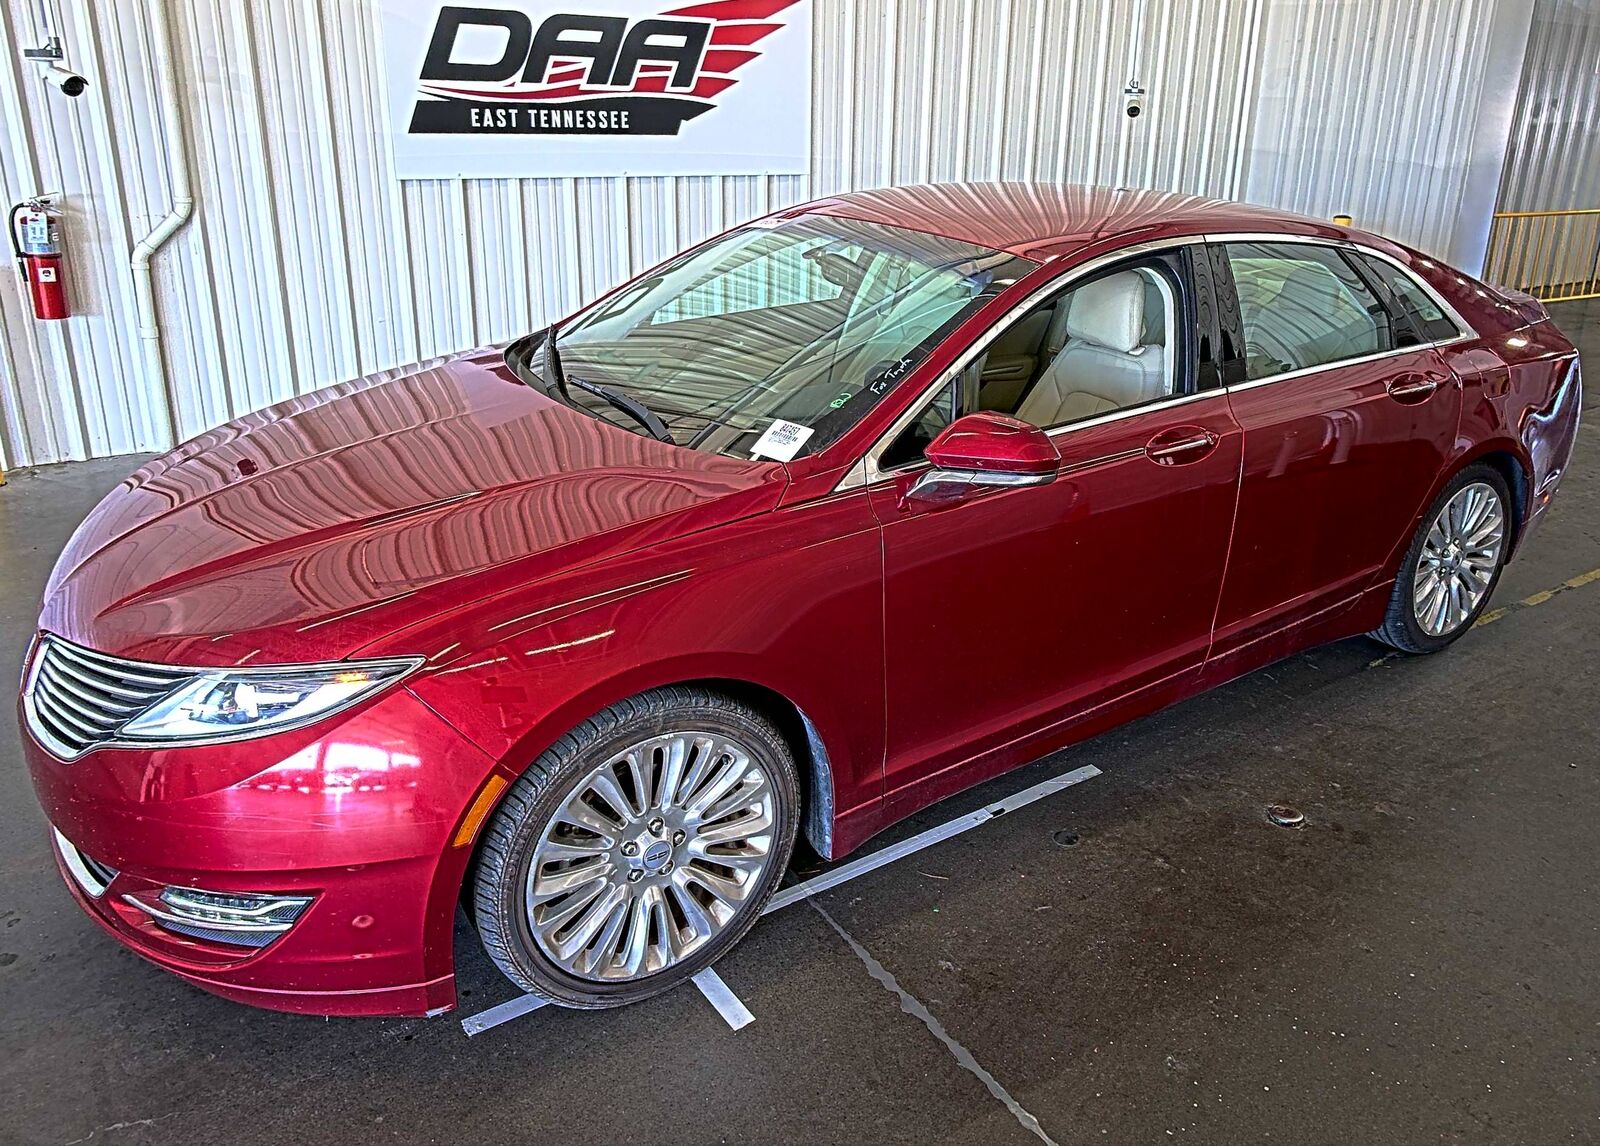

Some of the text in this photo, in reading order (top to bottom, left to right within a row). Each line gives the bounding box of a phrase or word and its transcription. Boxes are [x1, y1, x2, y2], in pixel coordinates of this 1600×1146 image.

[419, 6, 711, 87] DAA
[470, 107, 630, 130] EAST TENNESSEE
